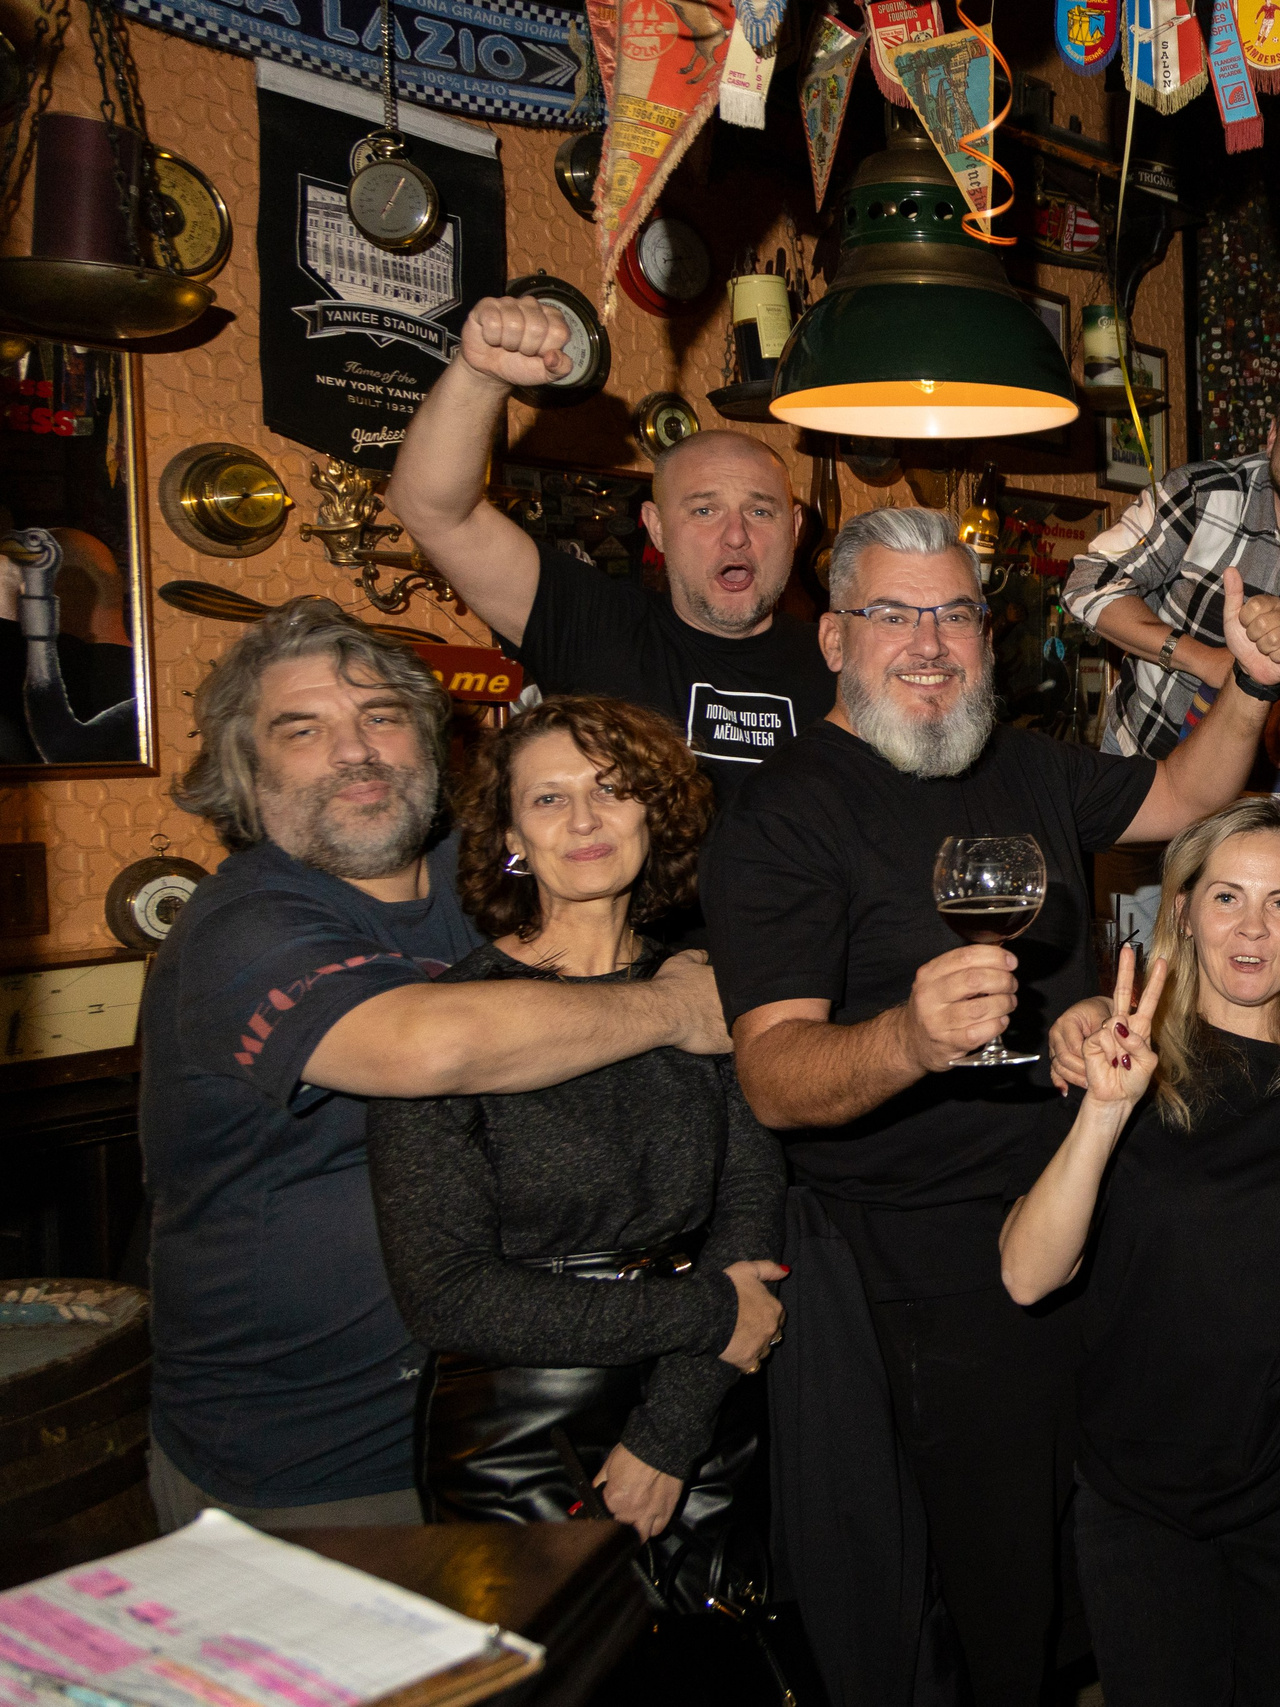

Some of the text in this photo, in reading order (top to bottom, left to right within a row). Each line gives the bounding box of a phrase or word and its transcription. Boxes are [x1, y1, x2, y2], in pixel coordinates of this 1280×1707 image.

[877, 2, 908, 15] SPORTING
[451, 5, 512, 29] GRANDE
[518, 19, 564, 40] STORIA
[321, 0, 527, 81] LAZIO
[1161, 41, 1172, 88] SALON
[1214, 56, 1242, 68] FLANDRES
[1219, 63, 1239, 73] ARTOIS
[421, 70, 461, 90] 100%
[463, 79, 508, 97] LAZIO
[726, 77, 751, 89] CASINO
[728, 69, 746, 80] PETIT
[326, 310, 439, 344] YANKEE STADIUM
[343, 360, 418, 385] Home of the
[316, 374, 347, 388] NEW
[349, 380, 384, 395] YORK
[346, 394, 414, 414] BUILT 1923
[1036, 540, 1057, 555] MY
[739, 711, 757, 727] ЧТО
[758, 712, 782, 729] ЕСТЬ
[713, 722, 745, 743] АЛЁША
[750, 730, 775, 747] ТЕБЯ
